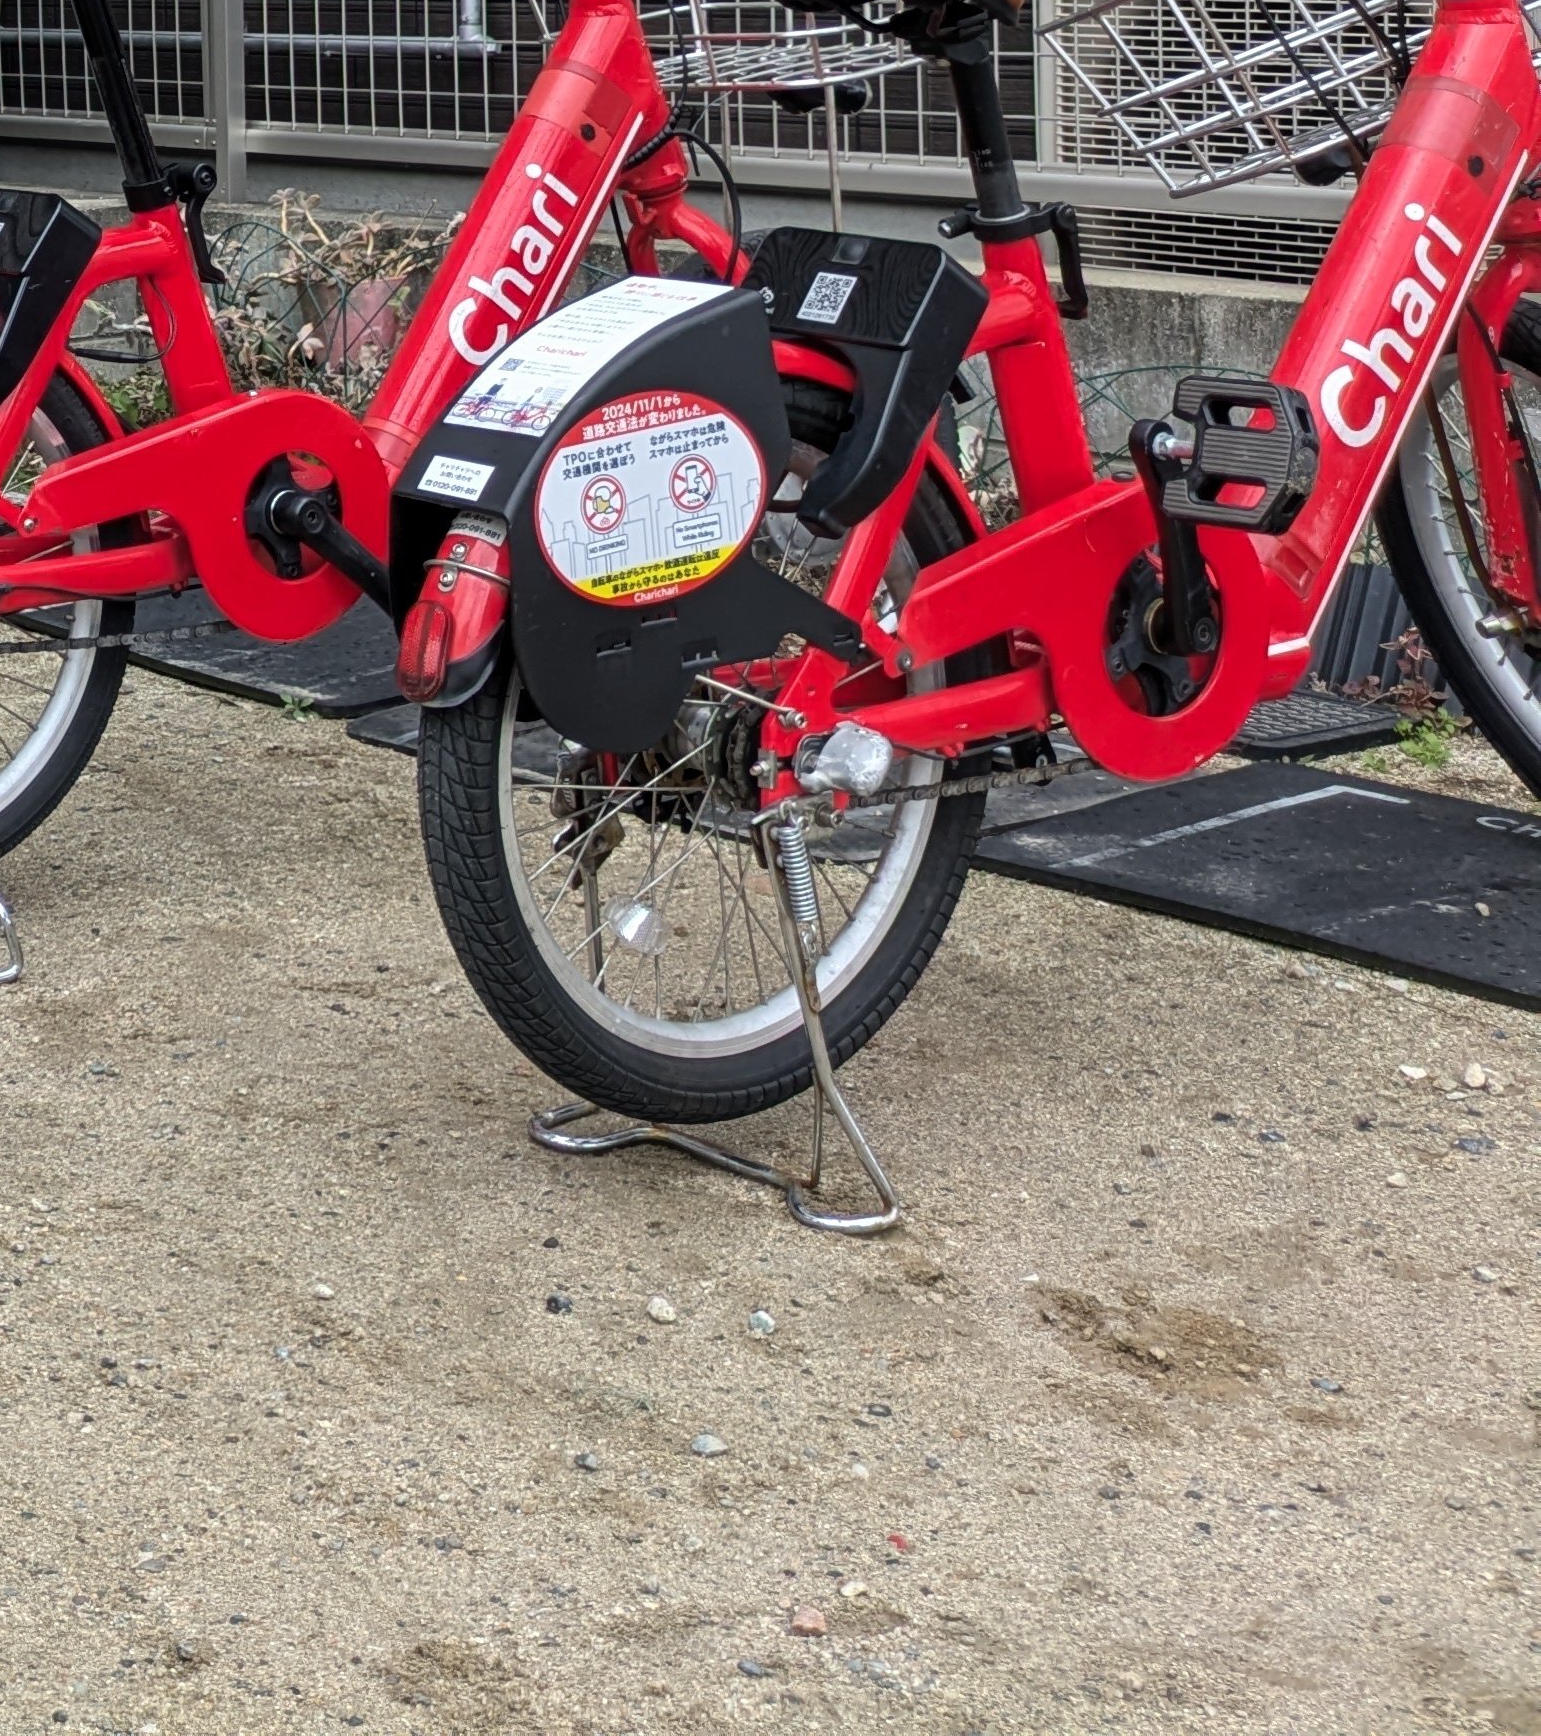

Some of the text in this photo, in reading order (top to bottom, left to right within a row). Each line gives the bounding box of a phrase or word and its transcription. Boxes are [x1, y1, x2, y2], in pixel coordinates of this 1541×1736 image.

[448, 163, 578, 365] Chari
[1320, 202, 1463, 448] Chari
[602, 394, 681, 421] 2024/11/1から
[582, 403, 707, 441] 道路交通法が変わりました。
[649, 420, 726, 446] ながらスマホは危険
[563, 441, 632, 467] TPOに合わせて
[649, 433, 729, 459] スマホは止まってから
[562, 453, 636, 481] 交通機関を選ぼう
[633, 584, 679, 604] Charichari
